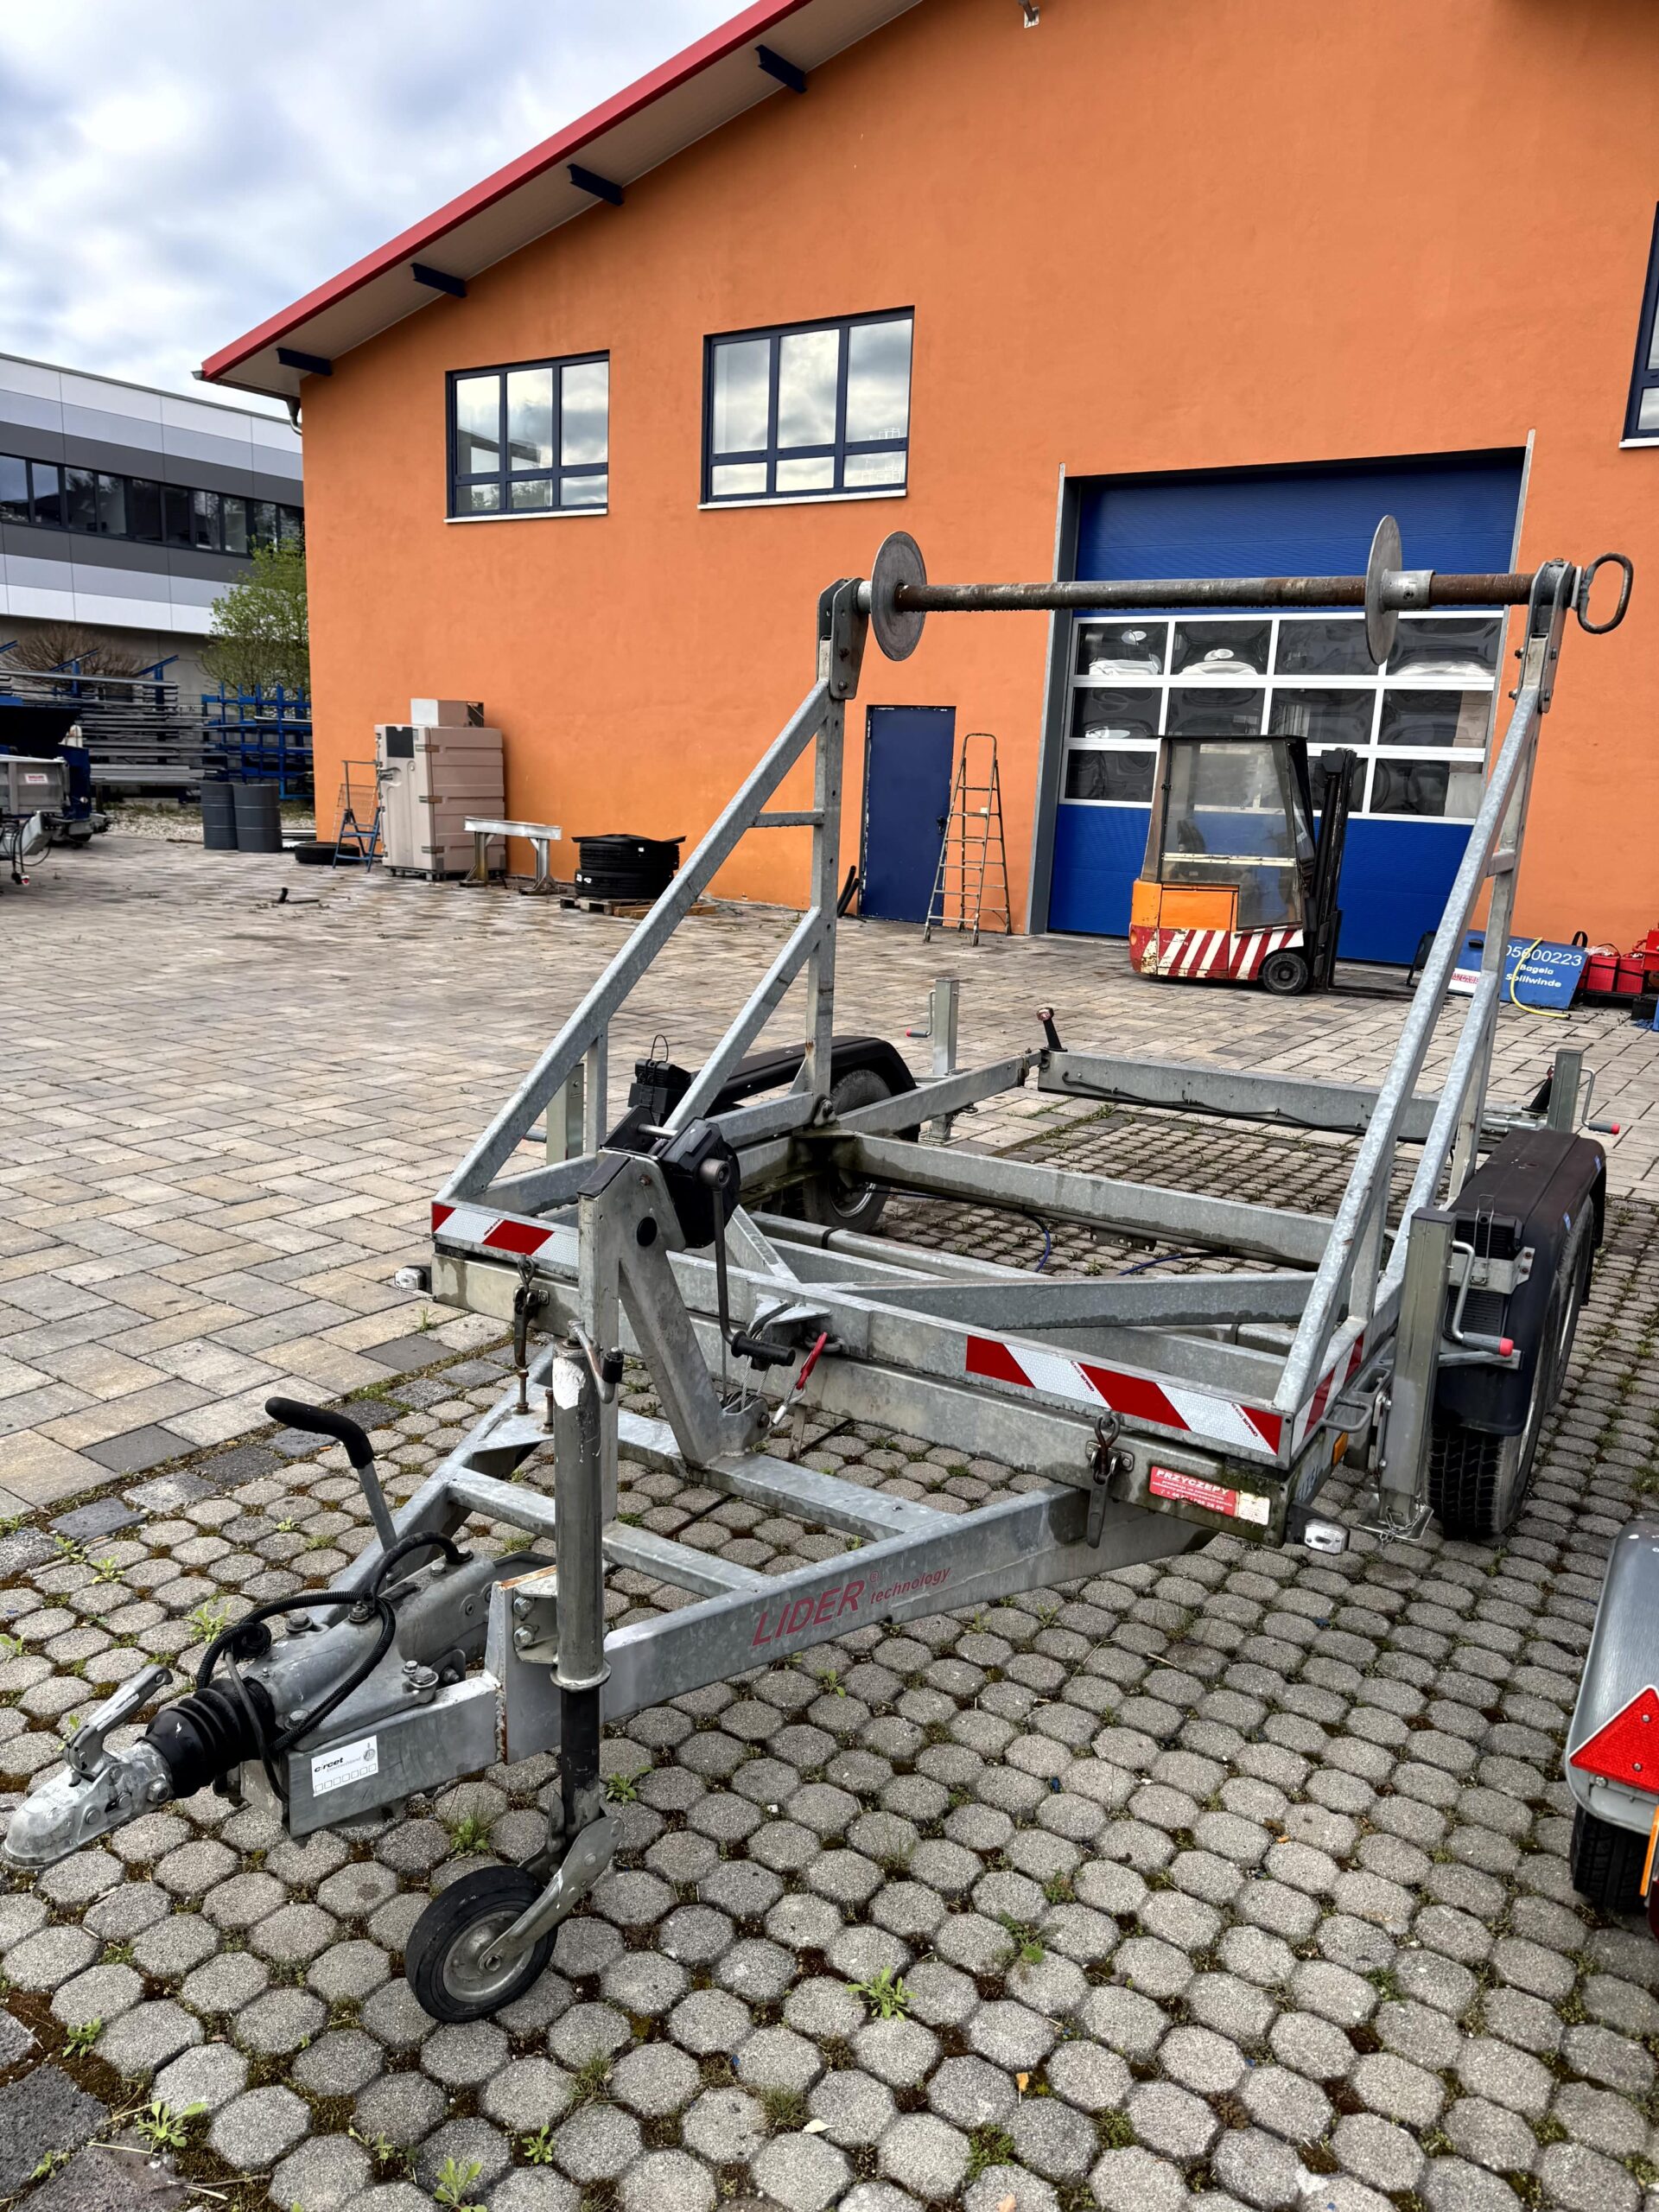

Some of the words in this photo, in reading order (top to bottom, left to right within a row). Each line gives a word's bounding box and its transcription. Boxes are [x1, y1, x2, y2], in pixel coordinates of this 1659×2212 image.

[1520, 963, 1554, 975] Bagela
[1156, 1470, 1230, 1495] PRZYCZEPY
[869, 1567, 951, 1605] technology
